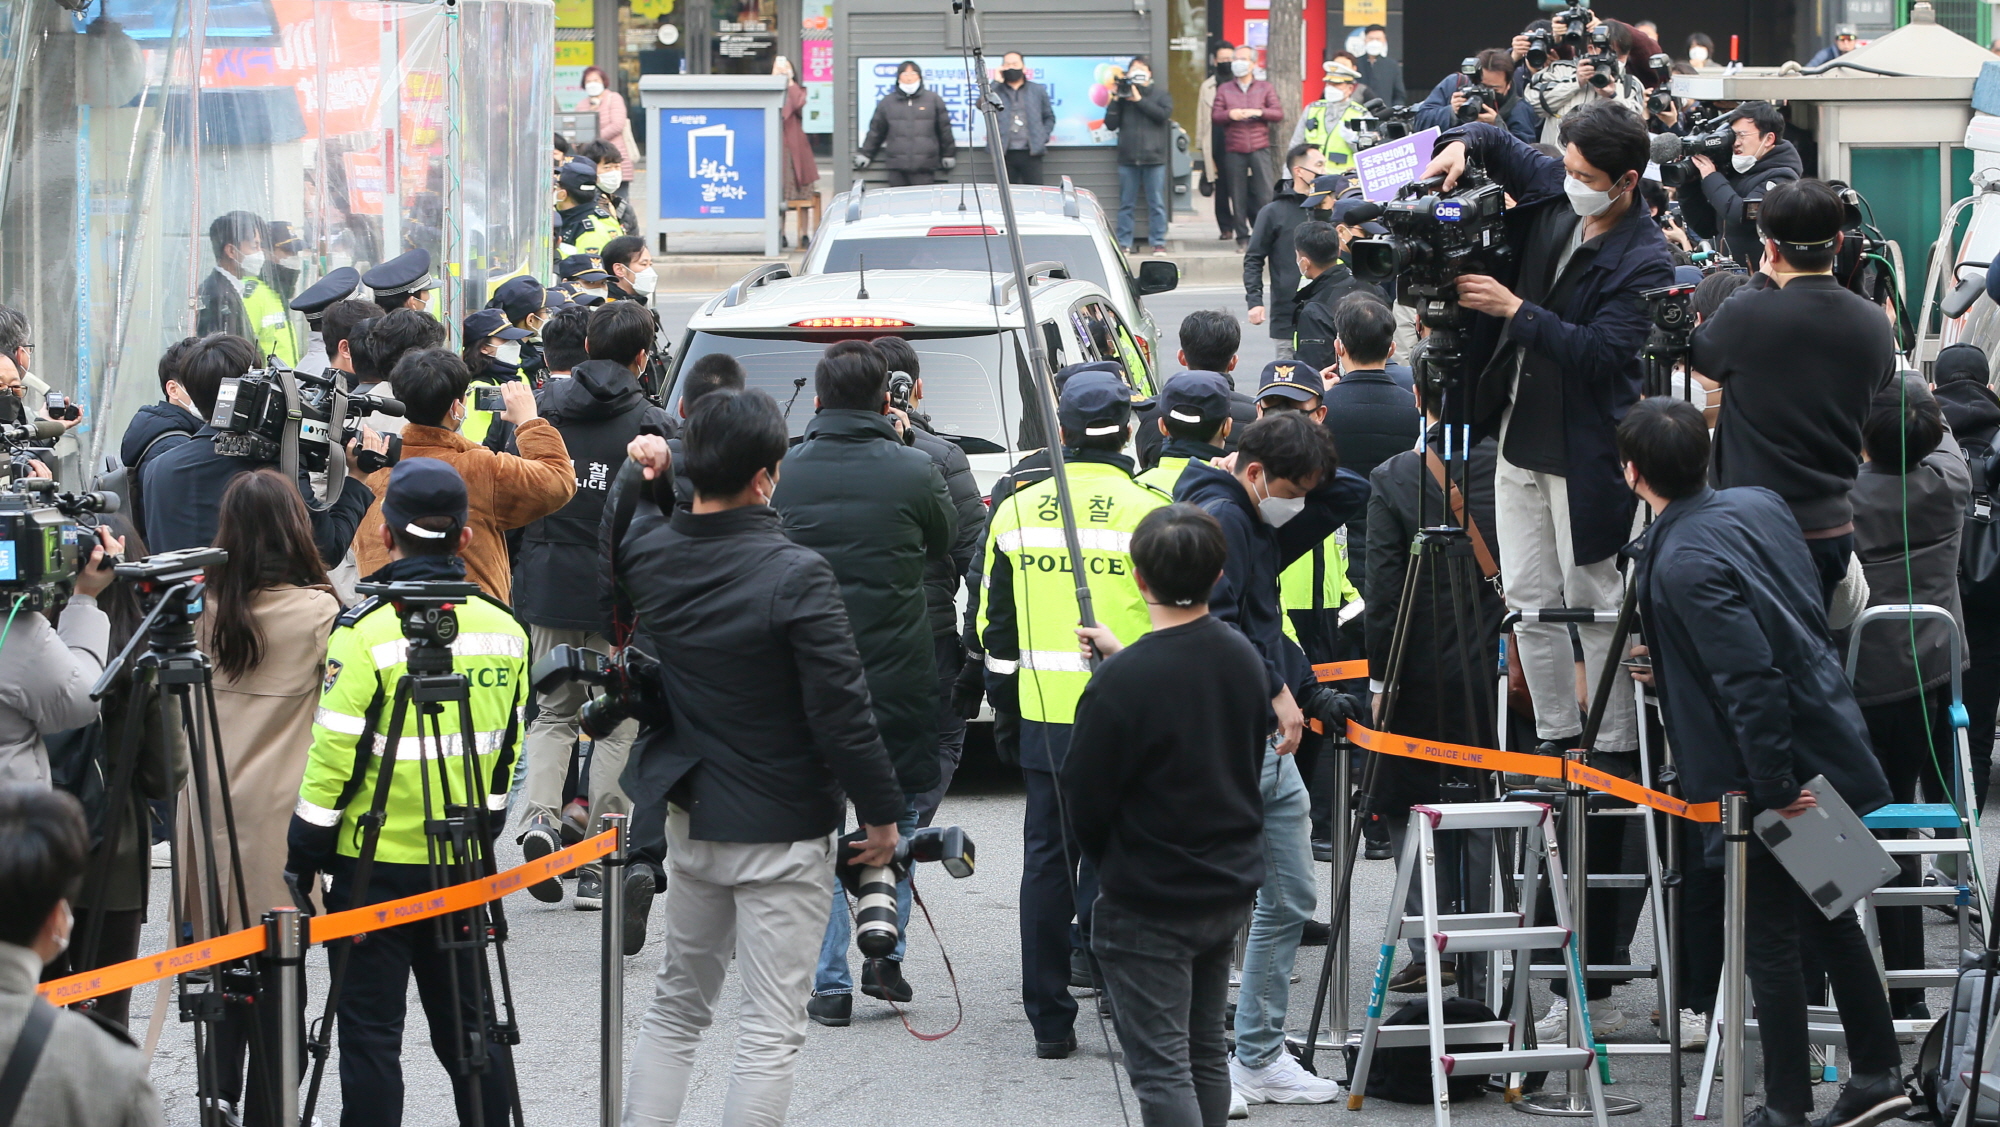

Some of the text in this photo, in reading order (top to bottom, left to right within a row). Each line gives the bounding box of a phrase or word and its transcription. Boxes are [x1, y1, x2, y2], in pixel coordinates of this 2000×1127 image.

[1705, 138, 1721, 147] KBS
[1361, 142, 1416, 168] 조주빈에게
[1364, 154, 1418, 180] 법정최고형
[1368, 169, 1415, 193] 선고하라!
[1436, 205, 1461, 218] OBS
[575, 477, 607, 491] LICE
[1019, 554, 1125, 576] POLCE
[466, 667, 510, 688] ICE
[1331, 667, 1343, 676] LINE
[1425, 746, 1483, 763] POLICE LINE
[1583, 772, 1600, 785] POLICE
[394, 896, 446, 918] POLICE LINE
[169, 947, 212, 967] POLICE LINE
[57, 977, 101, 998] POLICE LINE
